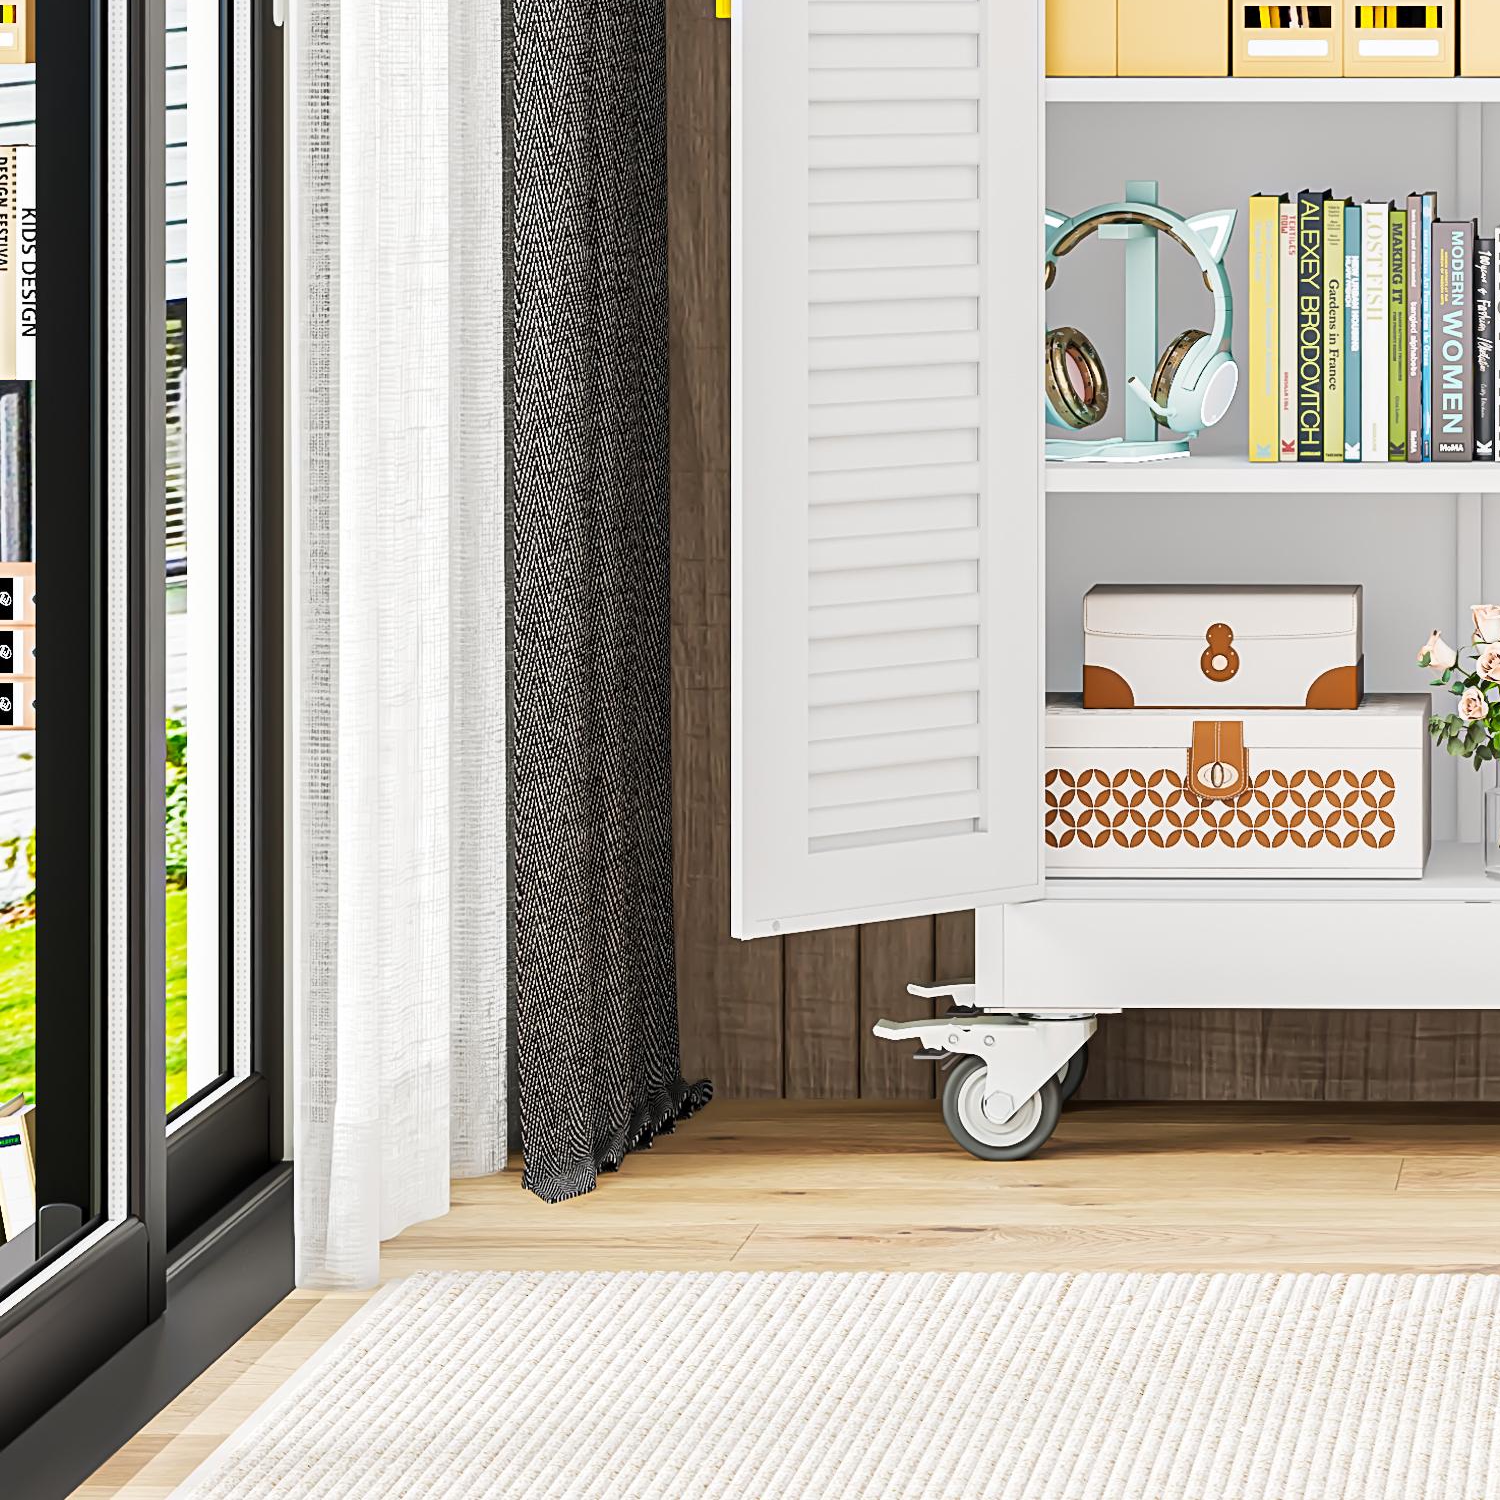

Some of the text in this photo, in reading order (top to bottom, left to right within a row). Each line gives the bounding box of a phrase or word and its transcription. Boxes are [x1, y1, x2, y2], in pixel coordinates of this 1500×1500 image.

[21, 208, 36, 337] KIDS DESIGN
[1366, 211, 1384, 321] LOST FISH
[1392, 222, 1403, 305] MAKING IT
[1451, 231, 1464, 306] MODERN
[1300, 199, 1320, 445] ALEXEY BRODOVITCH
[1328, 279, 1340, 391] Gardens in France
[1409, 301, 1418, 376] tangled alphabets
[1476, 299, 1492, 332] Fashion
[1442, 310, 1463, 434] WOMEN
[1439, 442, 1464, 452] MoMA
